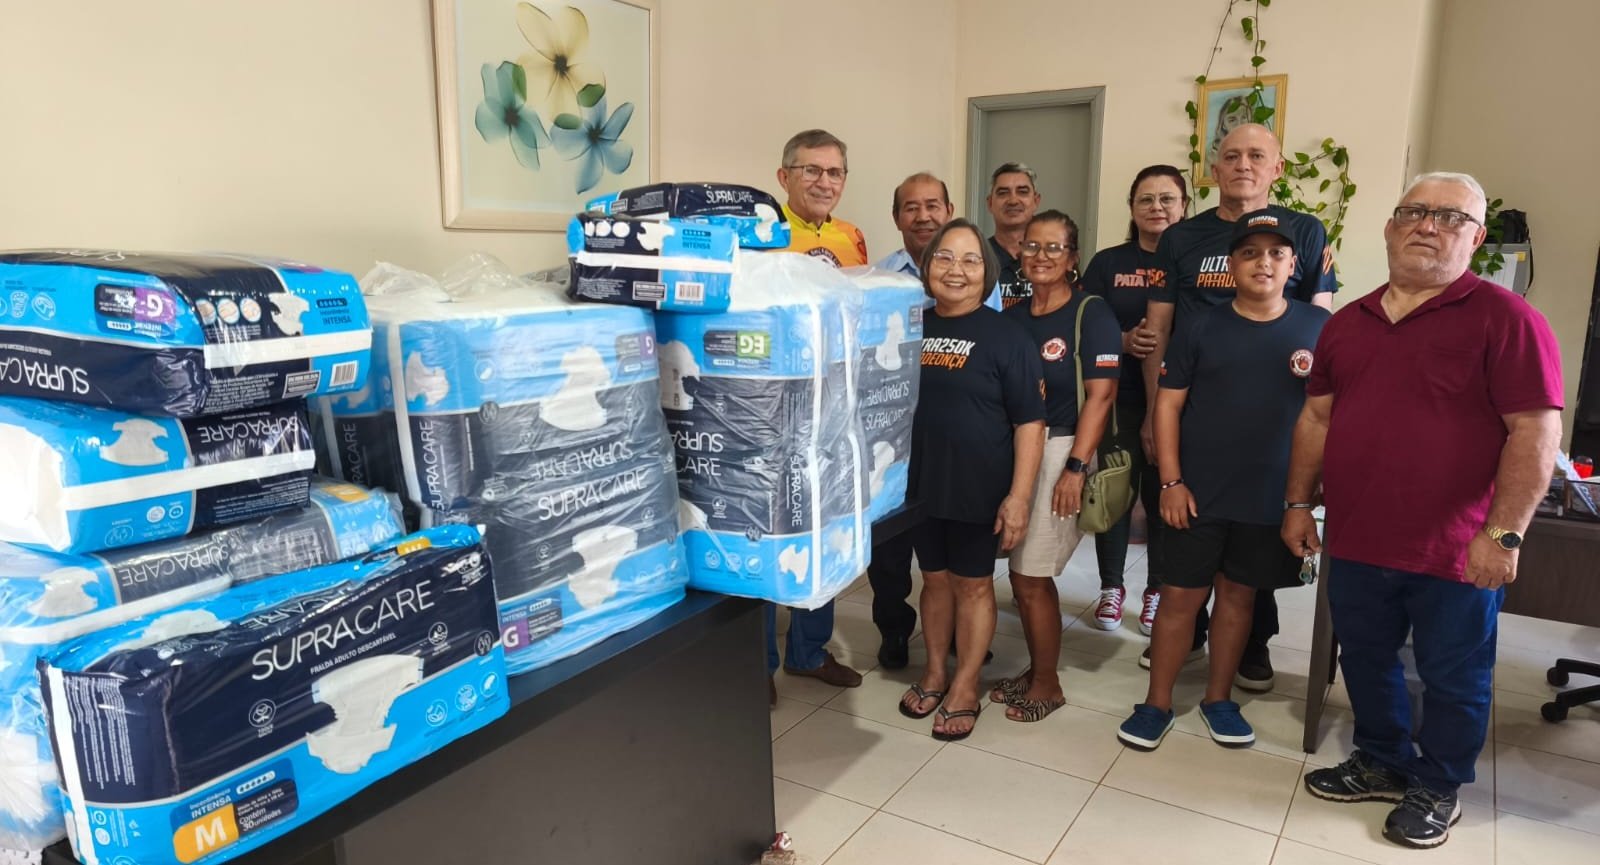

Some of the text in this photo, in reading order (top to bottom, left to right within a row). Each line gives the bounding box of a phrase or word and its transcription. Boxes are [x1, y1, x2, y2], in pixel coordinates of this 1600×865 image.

[739, 335, 765, 354] EG
[921, 337, 976, 356] TRA250K
[921, 352, 967, 369] DEONÇA
[0, 357, 90, 394] SUPRACA
[197, 416, 298, 443] SUPRACARE
[343, 423, 363, 483] RACARE
[419, 420, 445, 510] SUPRACARE
[537, 467, 651, 521] SUPRACARE
[790, 455, 802, 527] SUPRACARE
[118, 544, 229, 587] SUPRACARE
[252, 580, 435, 680] SUPRACARE
[503, 625, 519, 648] G
[310, 632, 396, 675] FRALDA ADULTO DESCARTÁVEL
[191, 795, 232, 819] INTENSA
[195, 815, 227, 853] M
